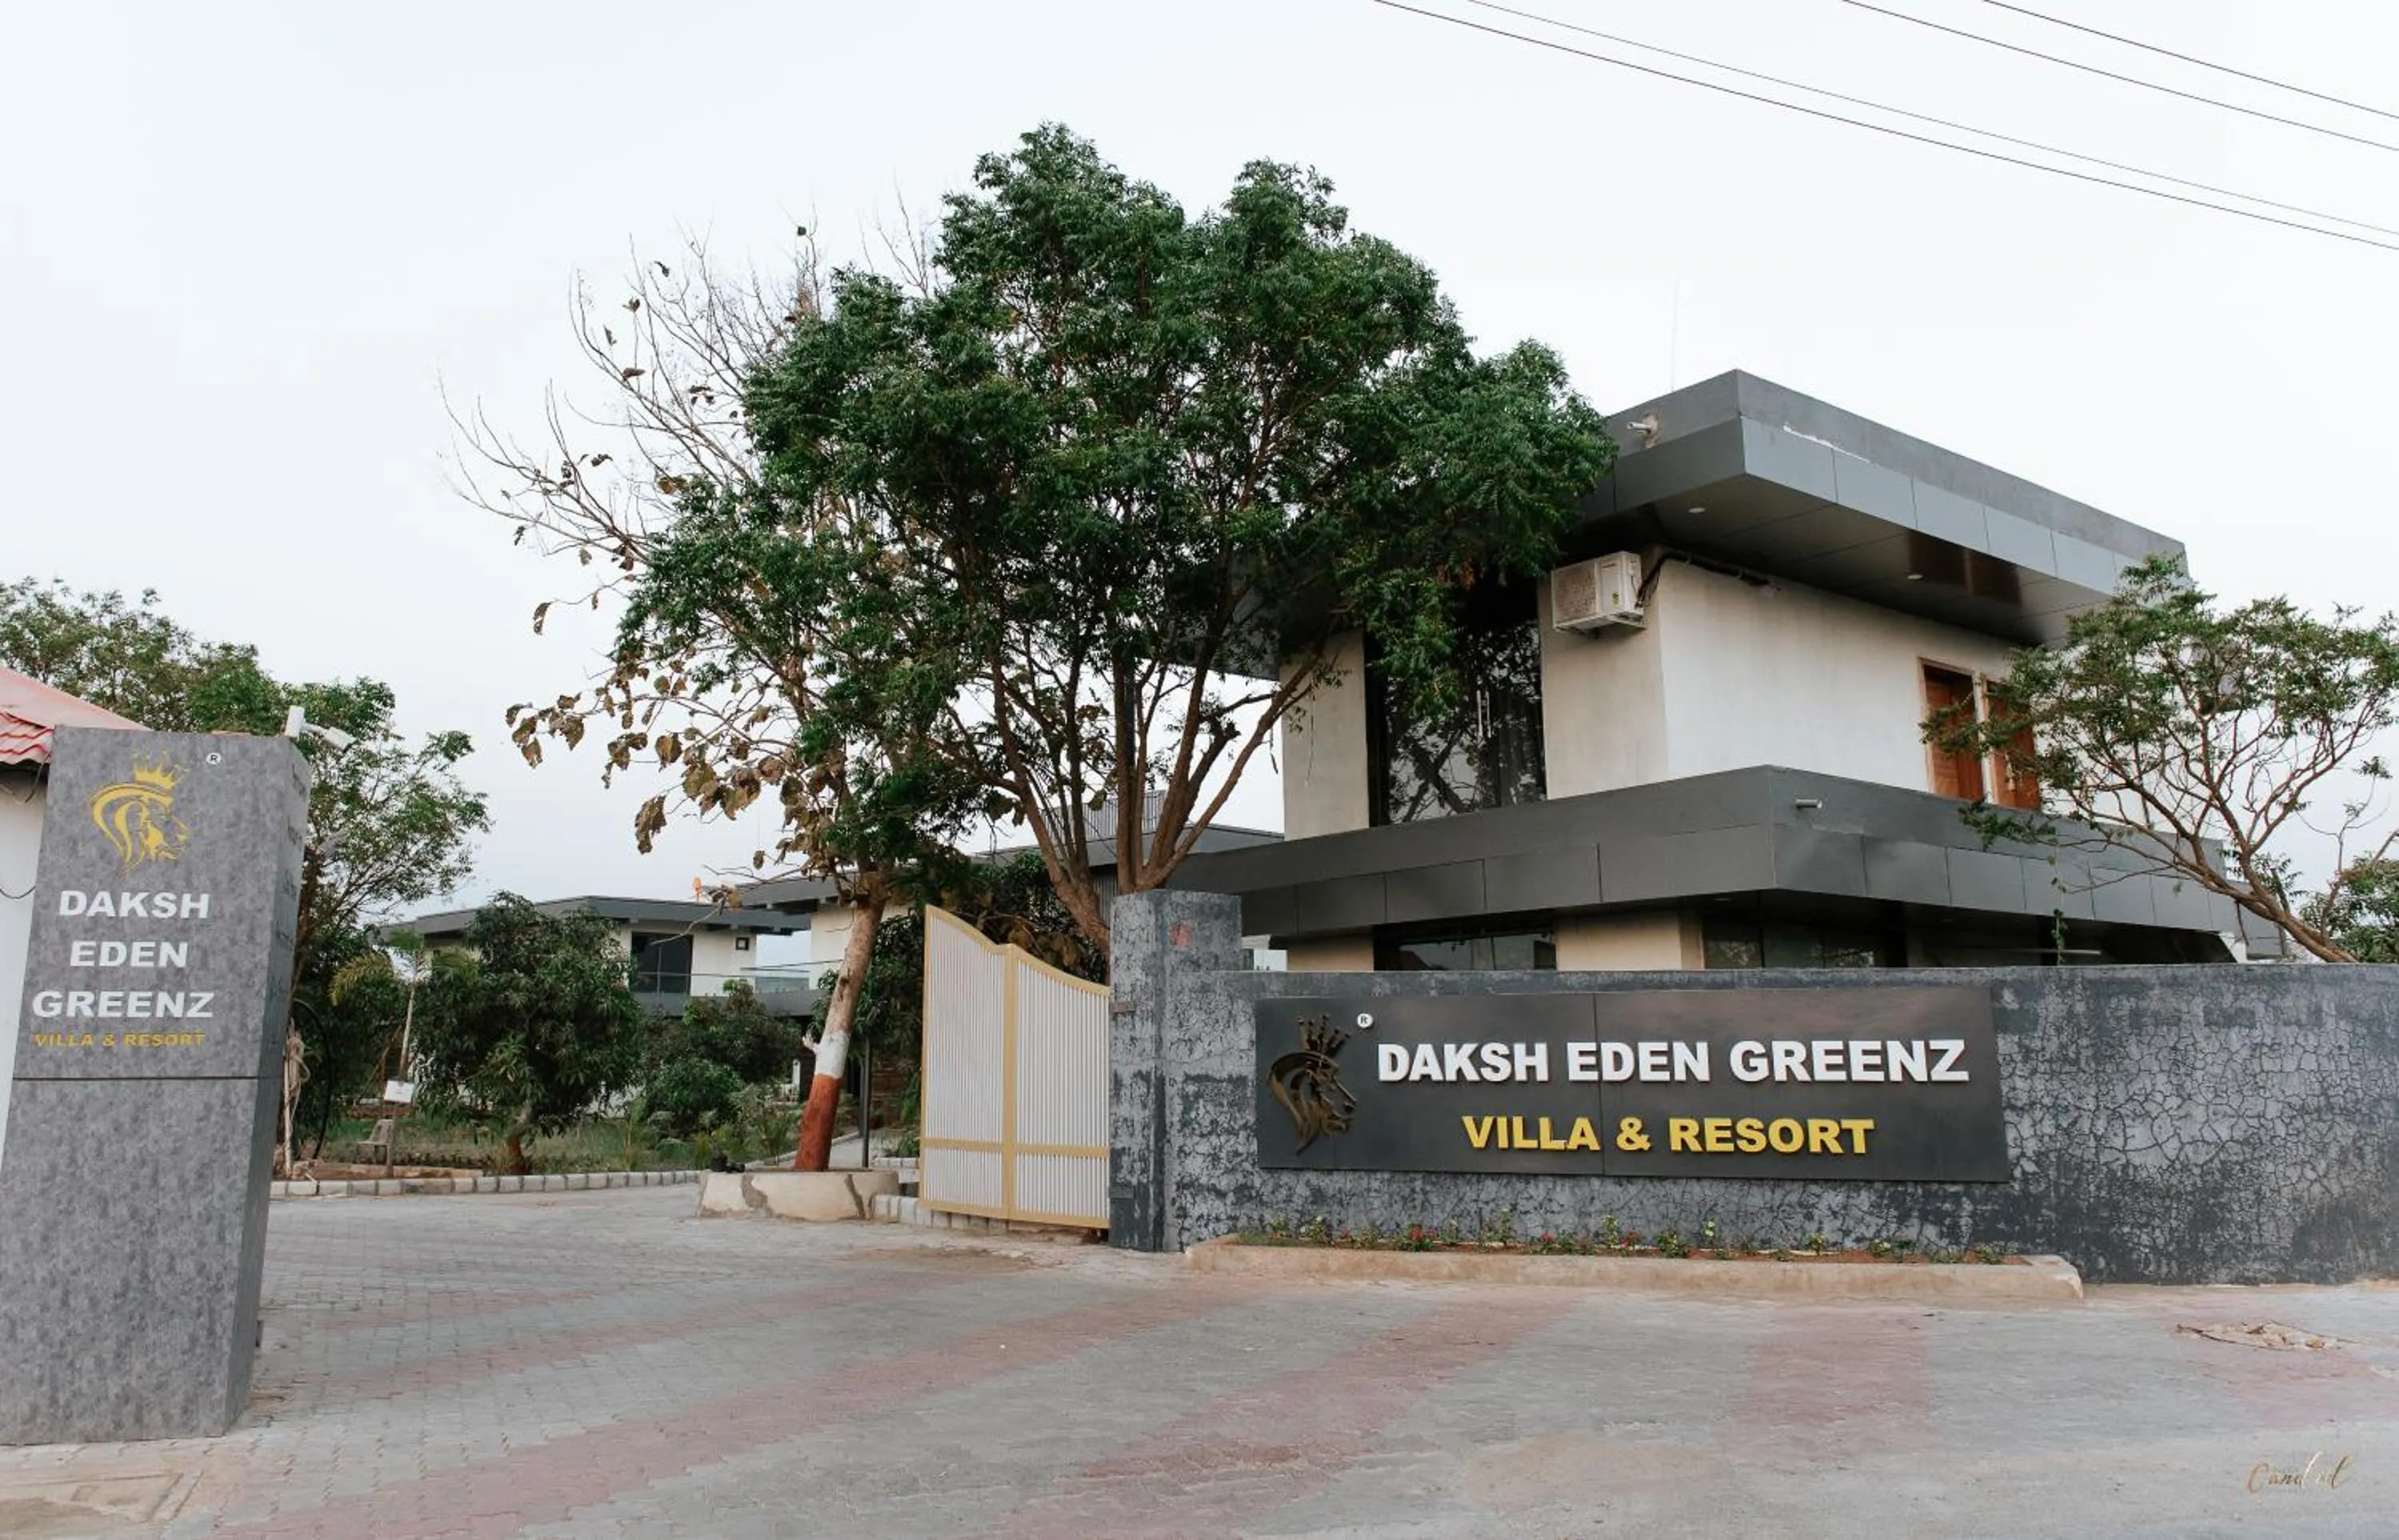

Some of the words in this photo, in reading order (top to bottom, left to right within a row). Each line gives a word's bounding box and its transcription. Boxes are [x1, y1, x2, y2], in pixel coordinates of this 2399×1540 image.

[59, 890, 210, 919] DAKSH
[70, 940, 189, 968] EDEN
[32, 991, 215, 1019] GREENZ
[34, 1033, 94, 1047] VILLA
[102, 1033, 116, 1047] &
[124, 1032, 206, 1047] RESORT
[1377, 1042, 1550, 1083] DAKSH
[1567, 1040, 1710, 1083] EDEN
[1729, 1039, 1970, 1083] GREENZ
[1462, 1115, 1601, 1151] VILLA
[1615, 1116, 1651, 1152] &
[1669, 1118, 1875, 1155] RESORT
